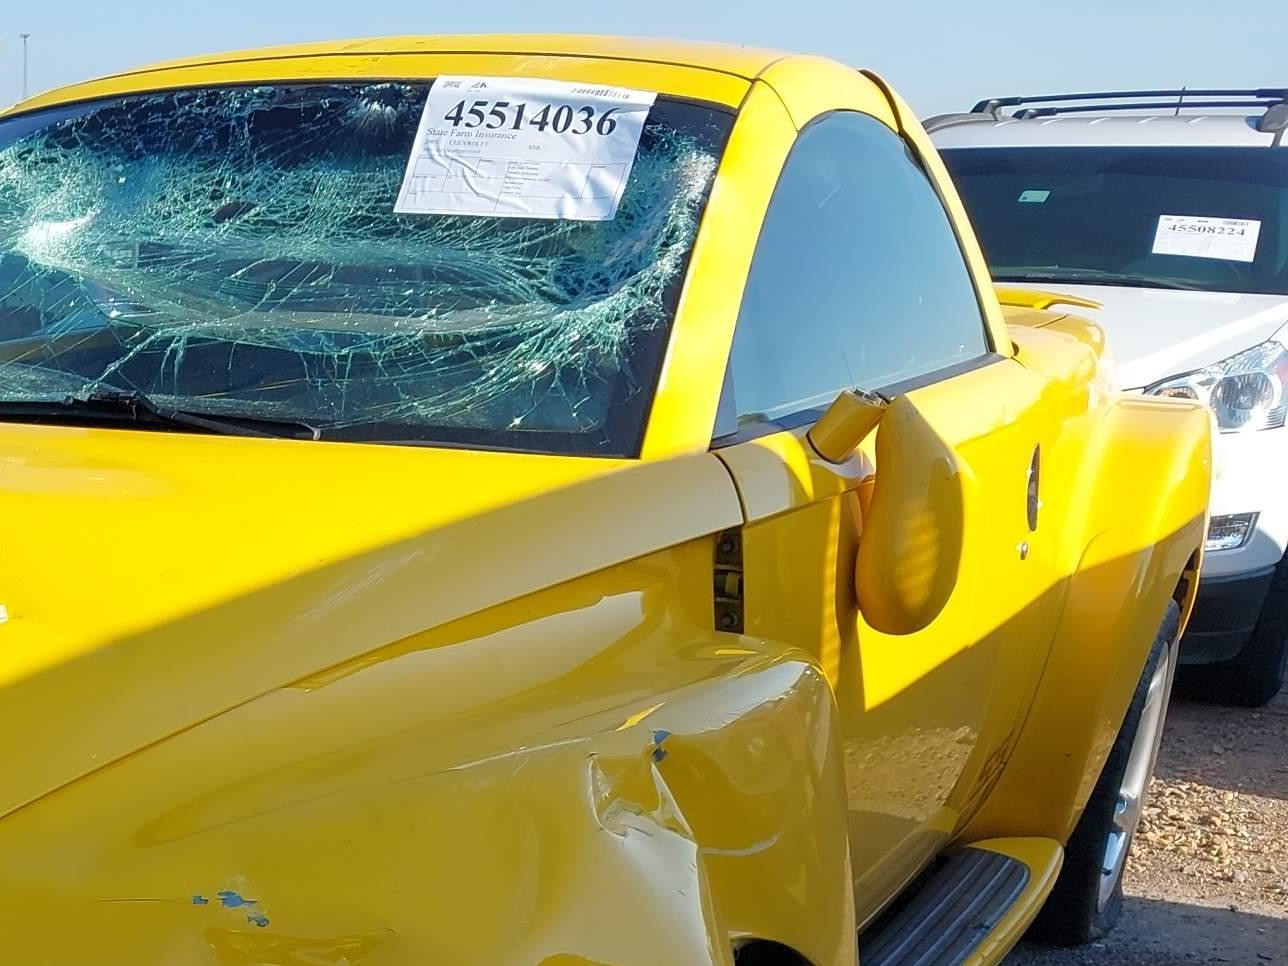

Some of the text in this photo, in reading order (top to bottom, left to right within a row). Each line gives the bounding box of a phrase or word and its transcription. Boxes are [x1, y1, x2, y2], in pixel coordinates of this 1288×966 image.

[444, 100, 621, 136] 45514036
[426, 127, 517, 140] State Farm Insurance
[1167, 224, 1245, 236] 45508224
